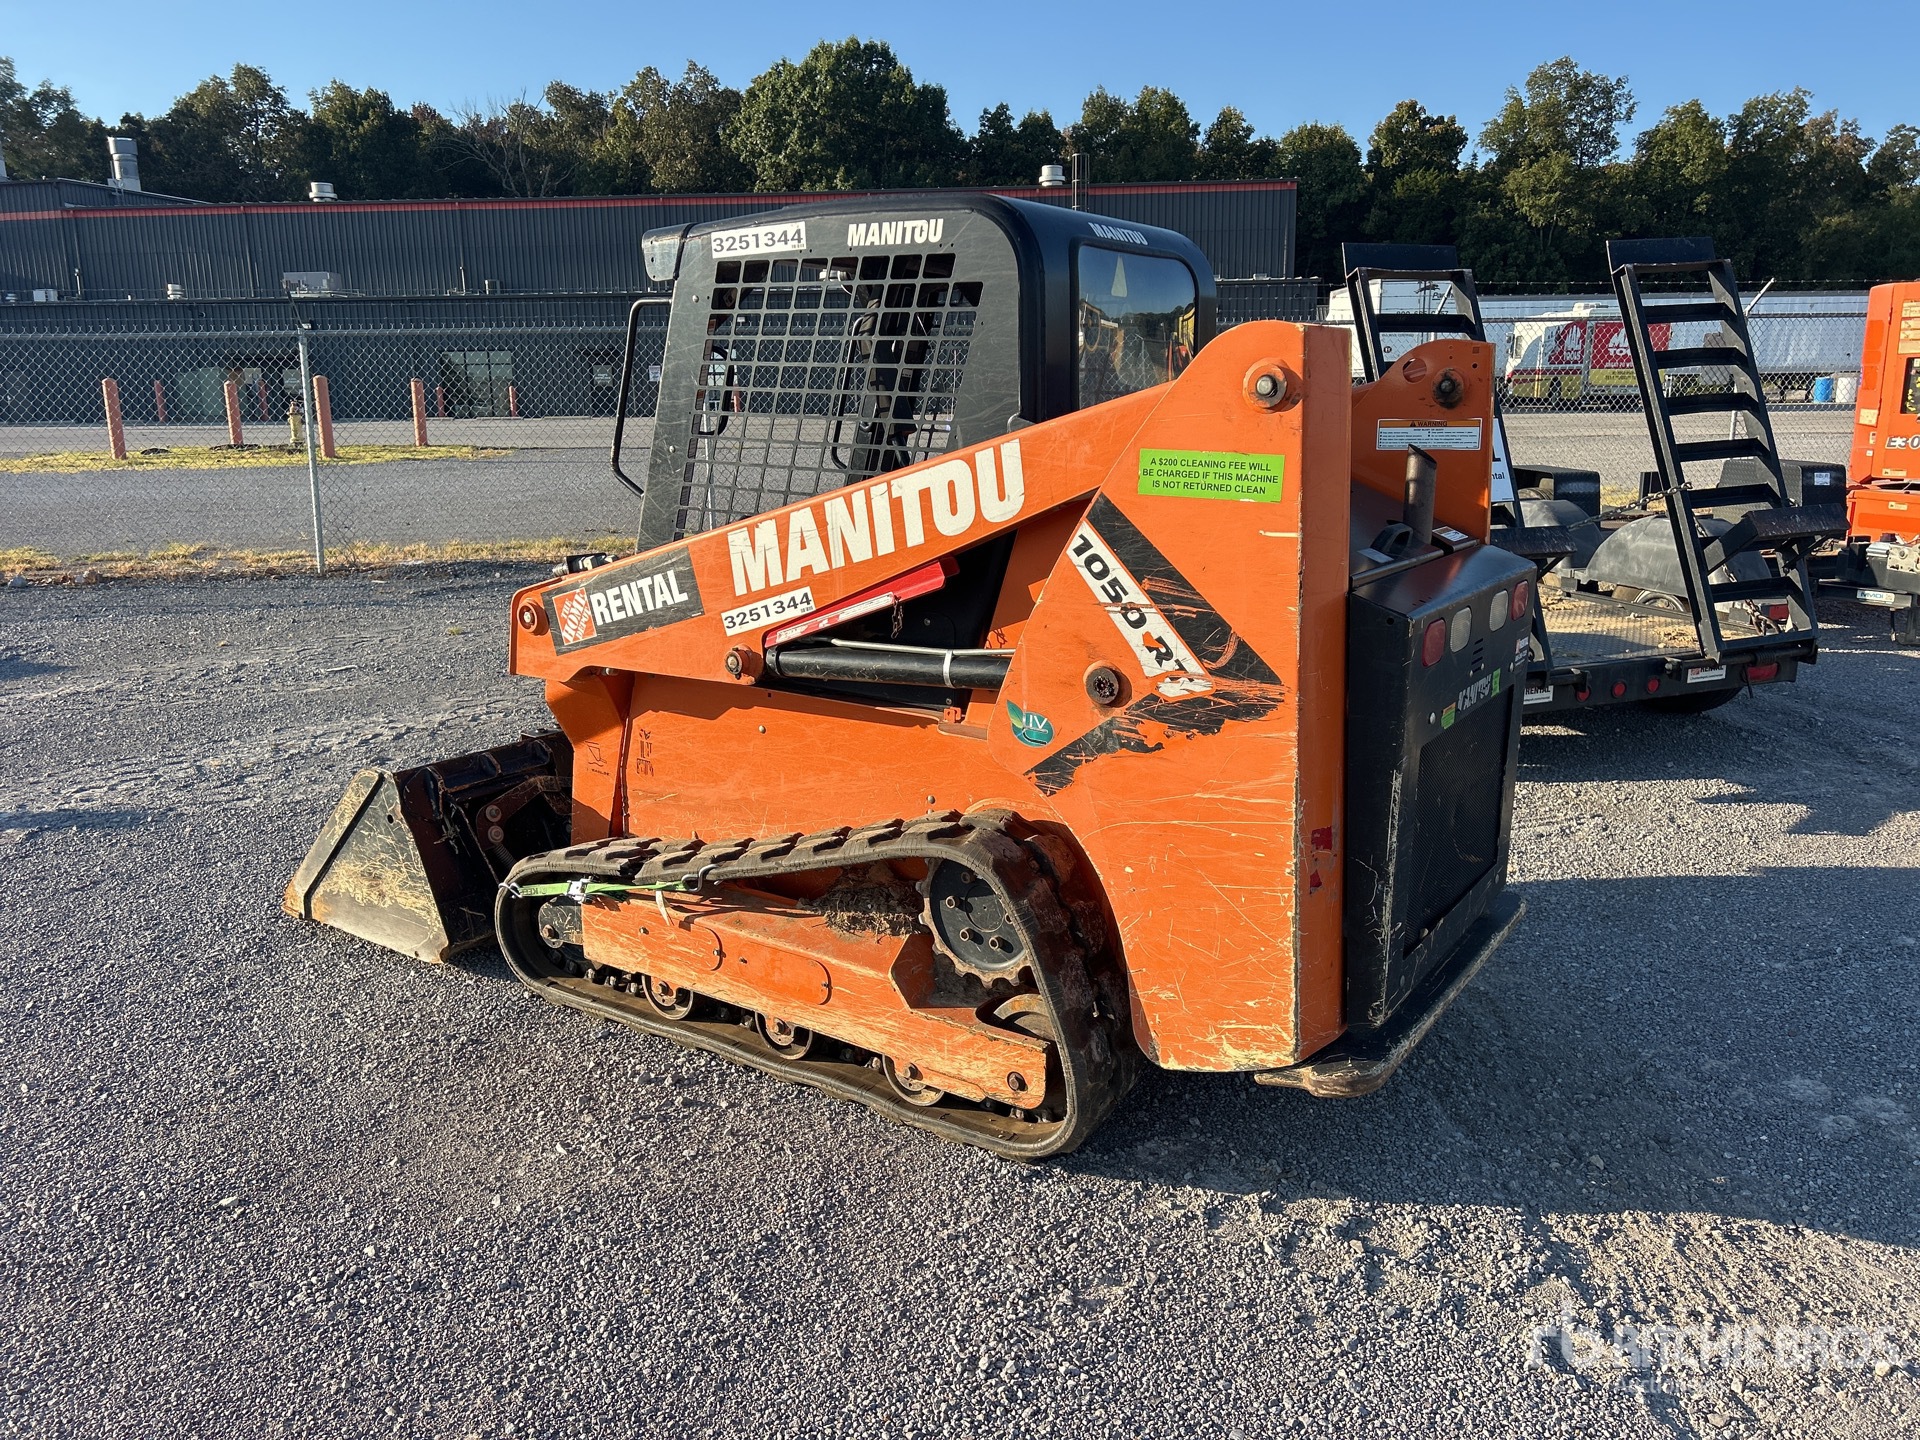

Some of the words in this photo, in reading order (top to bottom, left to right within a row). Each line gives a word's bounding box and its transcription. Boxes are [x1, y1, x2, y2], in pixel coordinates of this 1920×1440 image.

[712, 228, 803, 253] 3251344
[847, 218, 944, 247] MANITOU
[1088, 221, 1148, 246] MANITOU
[1142, 468, 1154, 476] BE
[1156, 469, 1200, 479] CHARGED
[1202, 471, 1210, 480] IF
[1212, 472, 1233, 481] THIS
[1235, 473, 1279, 484] MACHINE
[1150, 457, 1157, 466] A
[1158, 458, 1178, 467] $200
[1180, 459, 1226, 469] CLEANING
[1229, 461, 1246, 470] FEE
[1248, 462, 1271, 472] WILL
[1152, 480, 1161, 488] IS
[1162, 481, 1180, 489] NOT
[1183, 482, 1232, 492] RETURNED
[1234, 485, 1266, 495] CLEAN
[727, 438, 1025, 597] MANITOU
[1072, 533, 1148, 630] 1050
[561, 598, 574, 619] THE
[590, 569, 689, 626] RENTAL
[724, 592, 812, 631] 3251344
[562, 590, 586, 641] HOME
[575, 605, 590, 640] DEPOT
